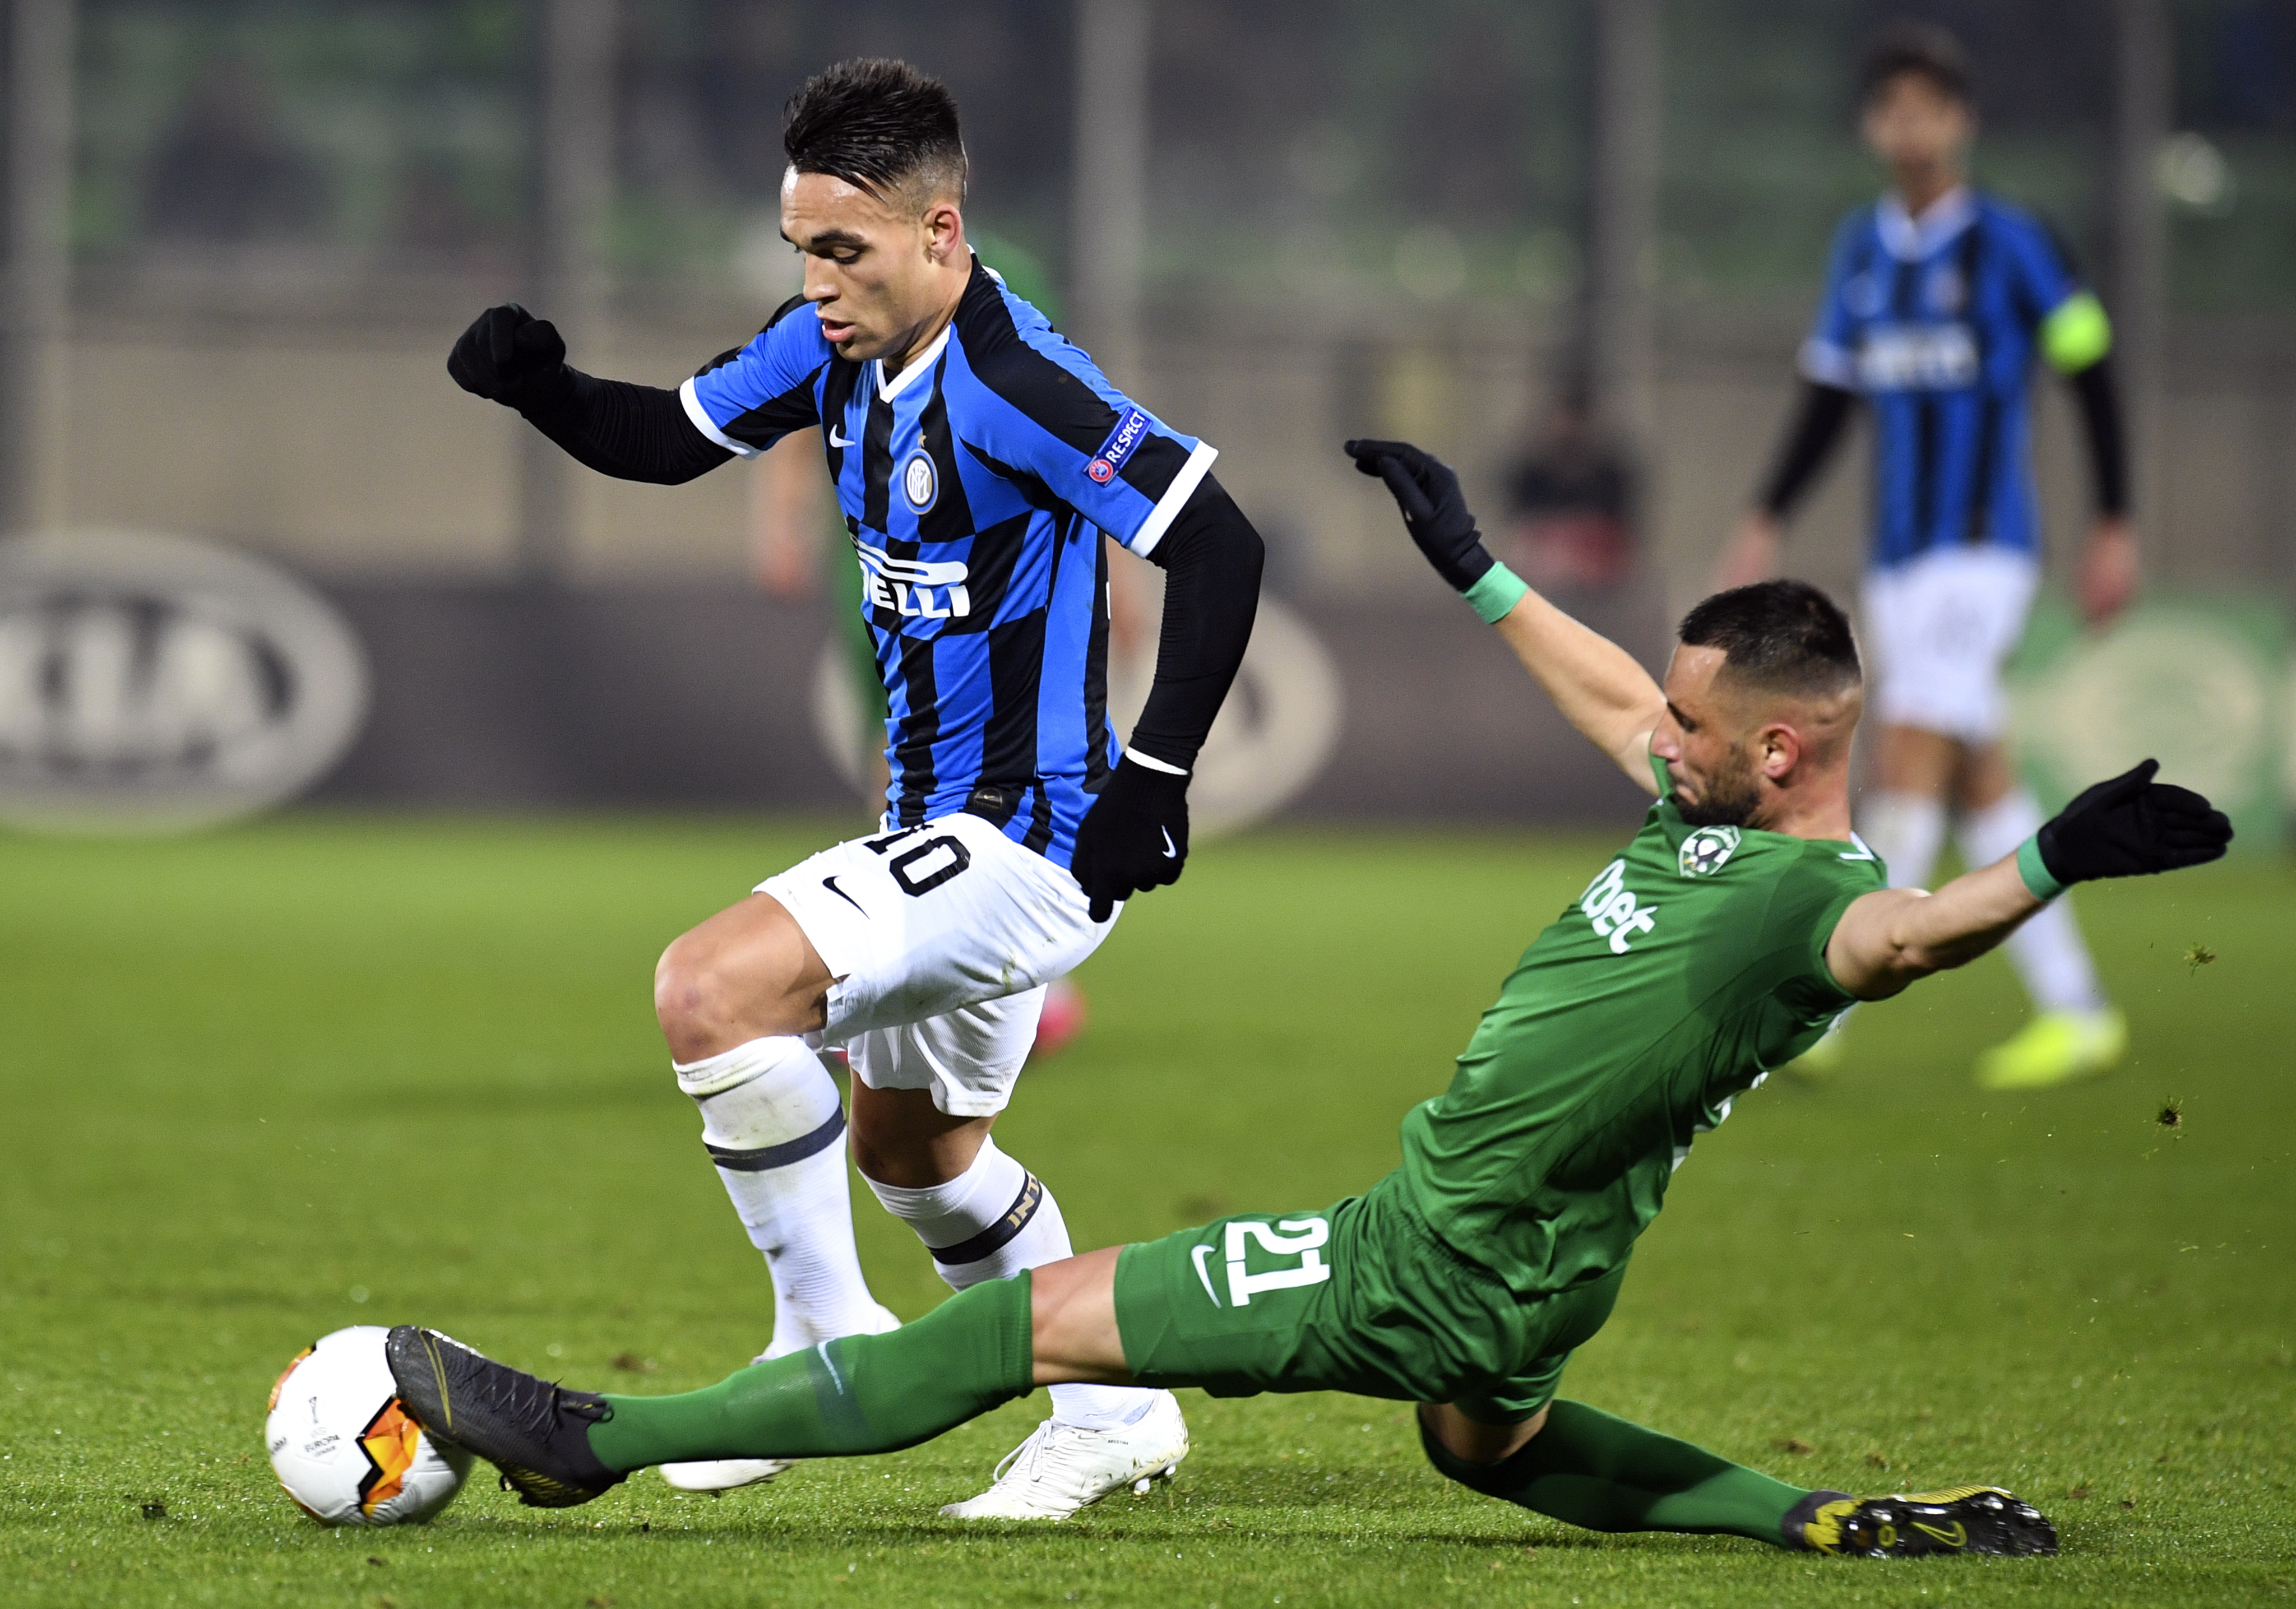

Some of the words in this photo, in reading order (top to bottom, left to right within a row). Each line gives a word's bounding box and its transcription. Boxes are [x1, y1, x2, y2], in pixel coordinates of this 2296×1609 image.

[1105, 411, 1145, 463] RESPECT
[862, 824, 971, 898] 10
[1225, 1217, 1331, 1307] 21
